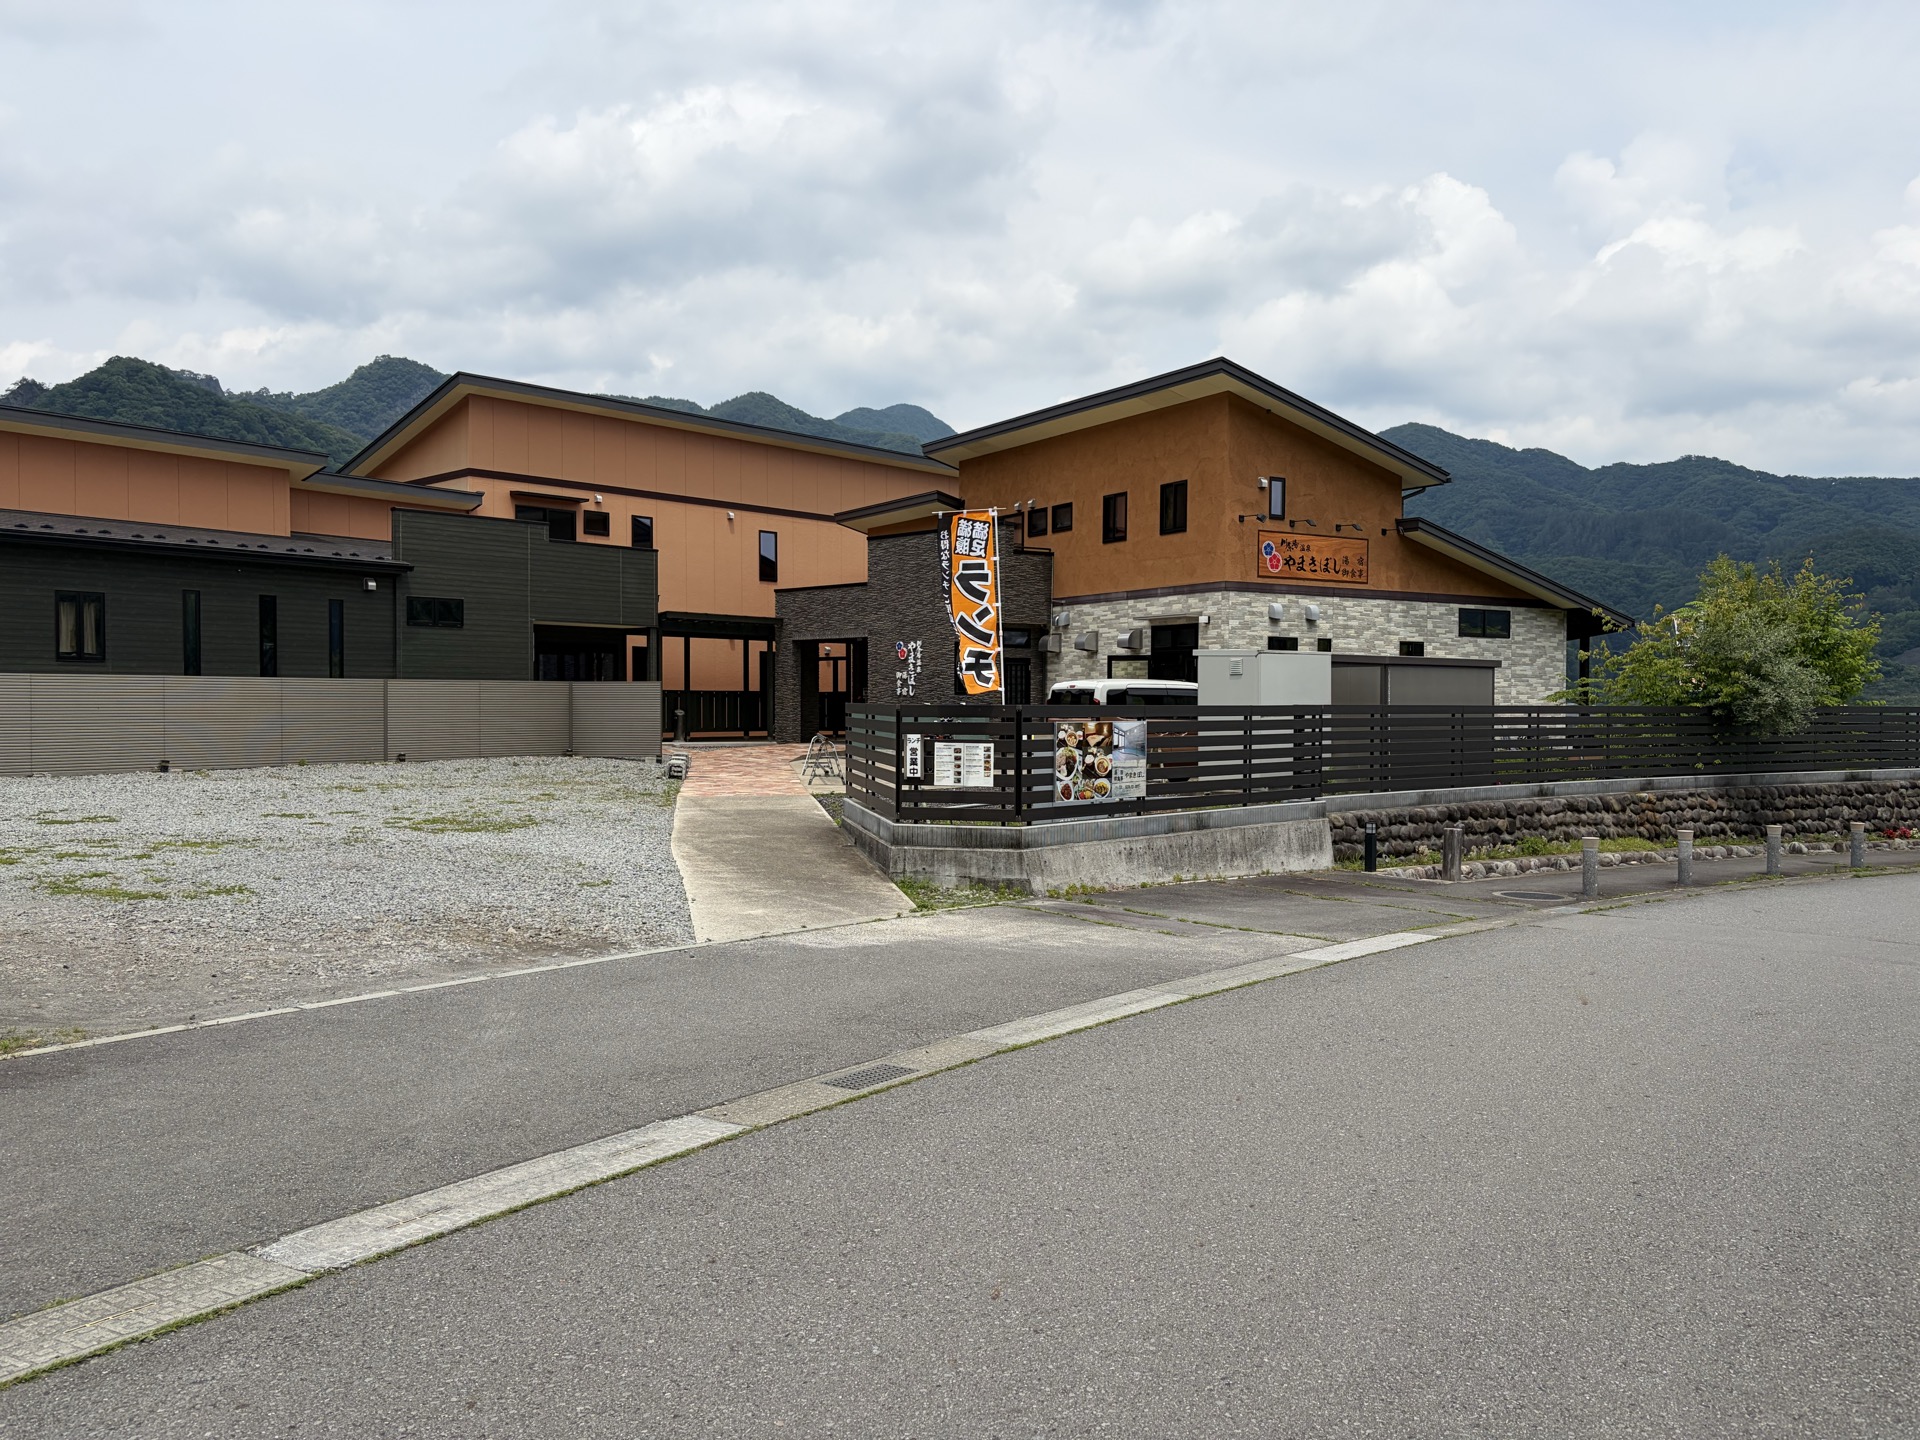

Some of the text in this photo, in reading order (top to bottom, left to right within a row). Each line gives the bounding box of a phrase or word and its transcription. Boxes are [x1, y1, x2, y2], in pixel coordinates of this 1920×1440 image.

[1284, 555, 1341, 575] やまきぼし
[909, 747, 918, 776] 営業中
